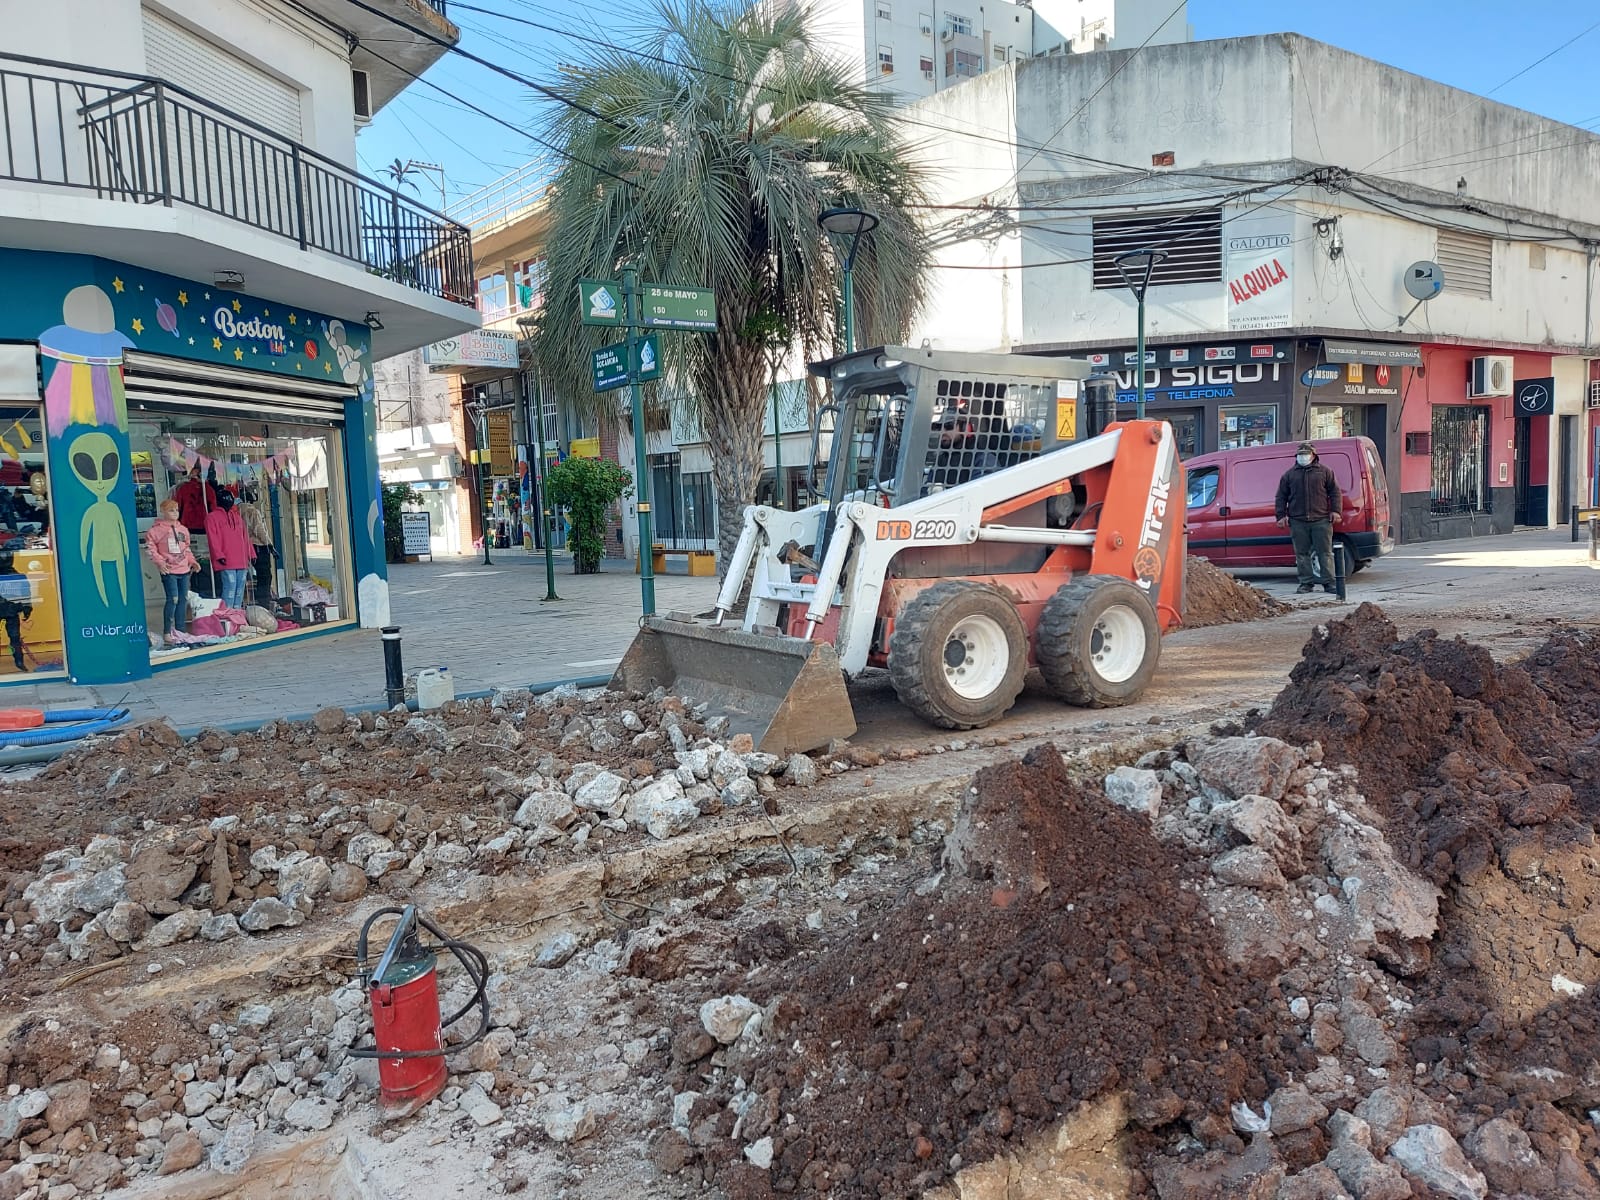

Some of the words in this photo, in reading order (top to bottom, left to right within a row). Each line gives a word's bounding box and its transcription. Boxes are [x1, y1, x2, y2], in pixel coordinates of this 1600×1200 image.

[1230, 236, 1290, 249] GALOTTO
[1229, 259, 1288, 305] ALQUILA
[651, 288, 662, 297] 25
[663, 290, 673, 298] de
[675, 291, 698, 300] MAYO
[696, 309, 708, 317] 100
[214, 307, 286, 341] Boston
[1220, 349, 1235, 357] LG
[1168, 389, 1235, 400] TELEFONIA
[1141, 475, 1170, 546] Trak
[876, 520, 912, 540] DTB
[914, 520, 956, 540] 2200
